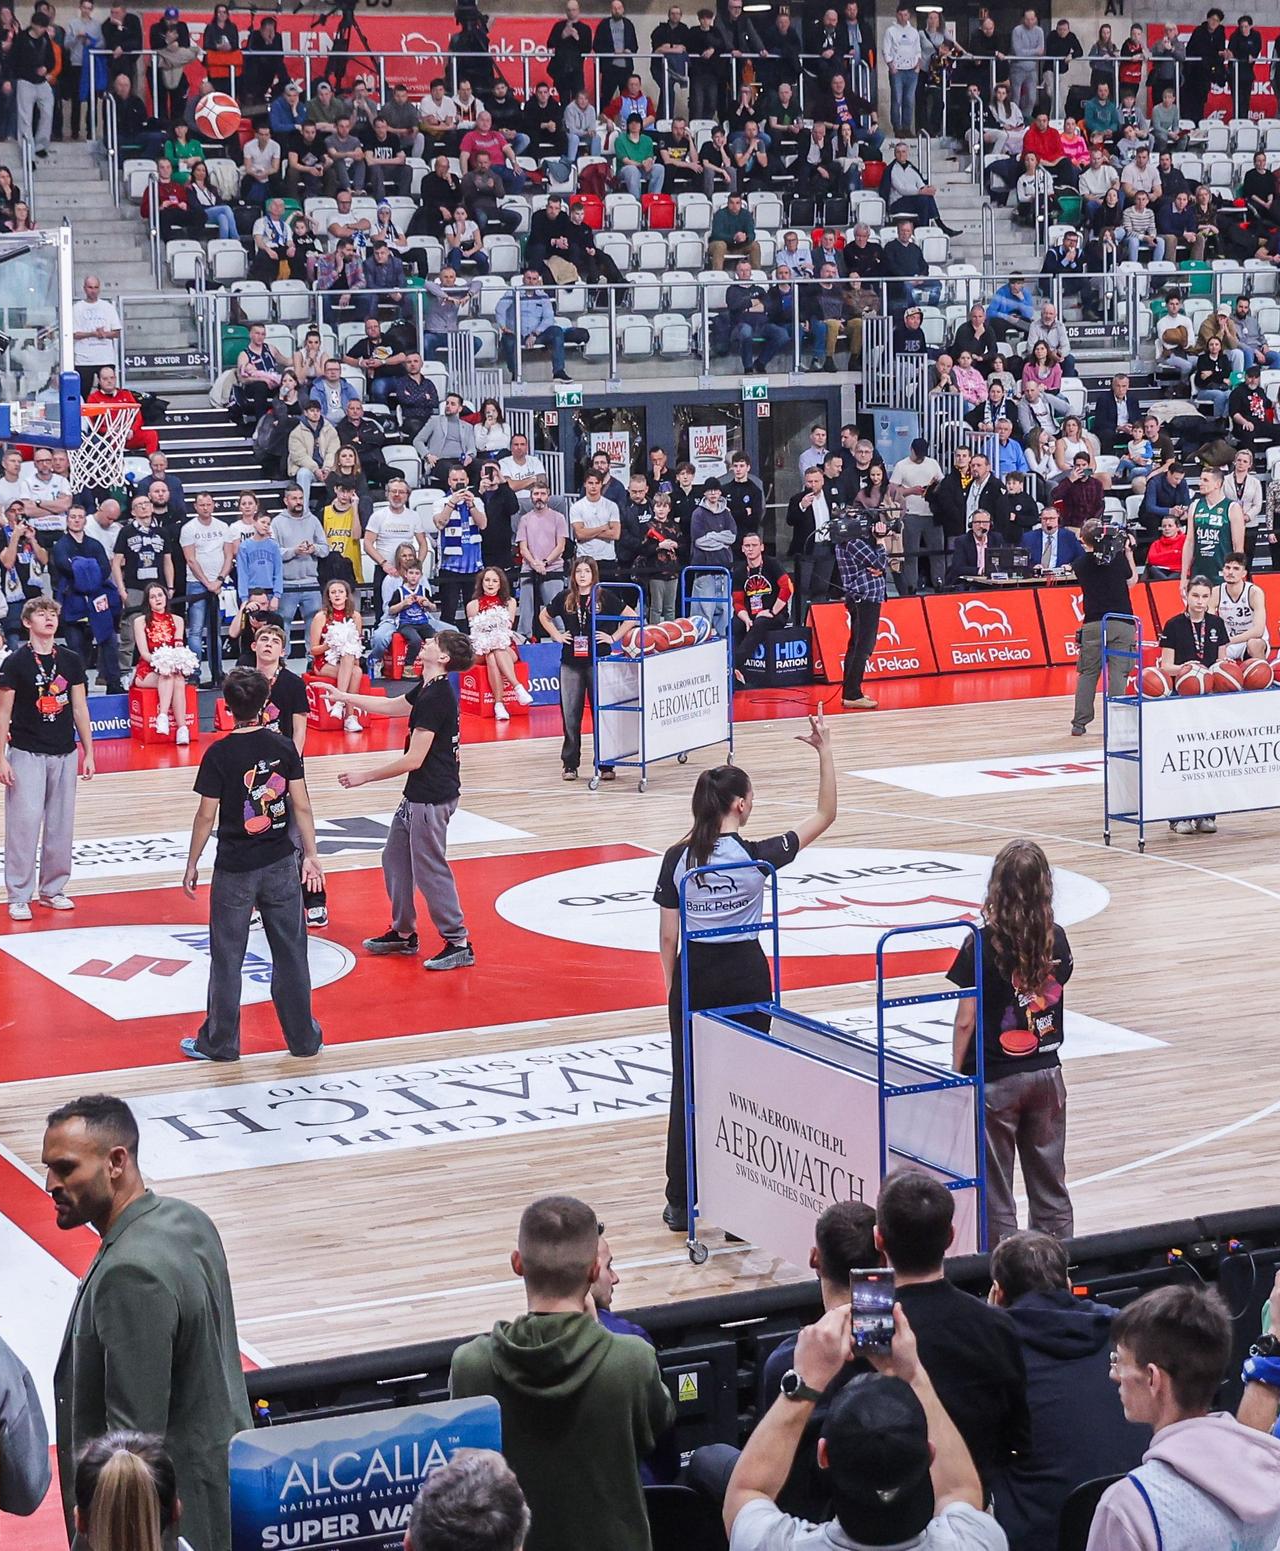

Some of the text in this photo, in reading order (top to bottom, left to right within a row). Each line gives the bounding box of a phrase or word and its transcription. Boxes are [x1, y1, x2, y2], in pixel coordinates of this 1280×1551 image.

[1084, 327, 1106, 336] SEKTOR
[153, 356, 181, 365] SEKTOR
[195, 531, 224, 540] GUESS
[1236, 607, 1252, 617] 32
[776, 640, 808, 660] HID
[952, 646, 1032, 665] Bank Pekao
[744, 660, 766, 669] ATION
[776, 657, 809, 669] RATION
[877, 656, 920, 673] Pekao
[650, 685, 720, 721] AEROWATCH
[1181, 771, 1206, 783] SWISS
[1207, 768, 1243, 780] WATCHES
[1243, 766, 1266, 777] SINCE
[686, 899, 749, 912] Bank Pekao
[728, 1091, 847, 1157] WWW.AEROWATCH.PL
[715, 1115, 865, 1203] AEROWATCH
[735, 1162, 824, 1214] SWISS WATCHES SINCE
[279, 1438, 449, 1500] ALCALIA
[279, 1492, 363, 1513] NATURALNIE
[261, 1512, 360, 1550] SUPER
